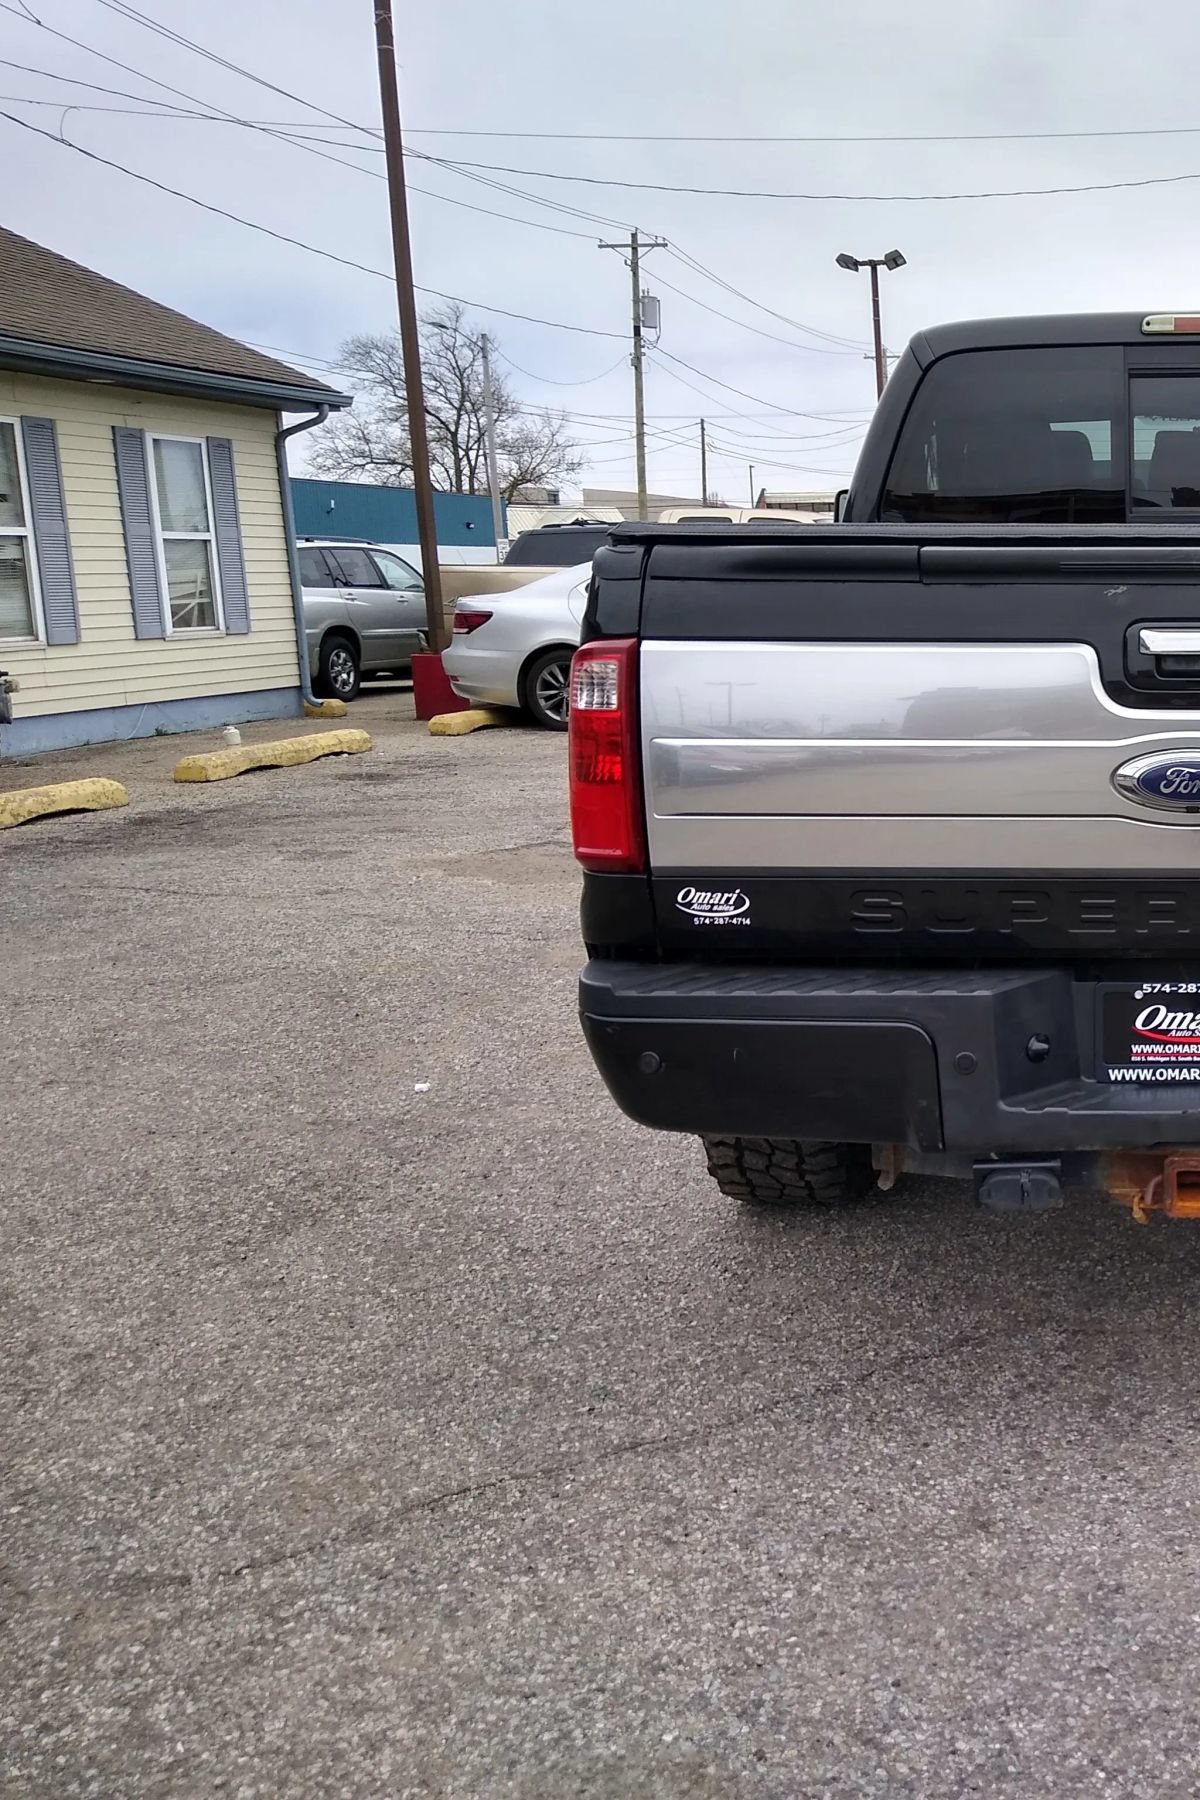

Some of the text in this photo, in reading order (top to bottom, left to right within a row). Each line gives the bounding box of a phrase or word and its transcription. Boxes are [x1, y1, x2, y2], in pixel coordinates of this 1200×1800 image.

[677, 887, 741, 904] Omari
[850, 889, 1190, 932] SUPER
[693, 917, 751, 925] 574-287-4714
[1168, 1029, 1192, 1037] Auto
